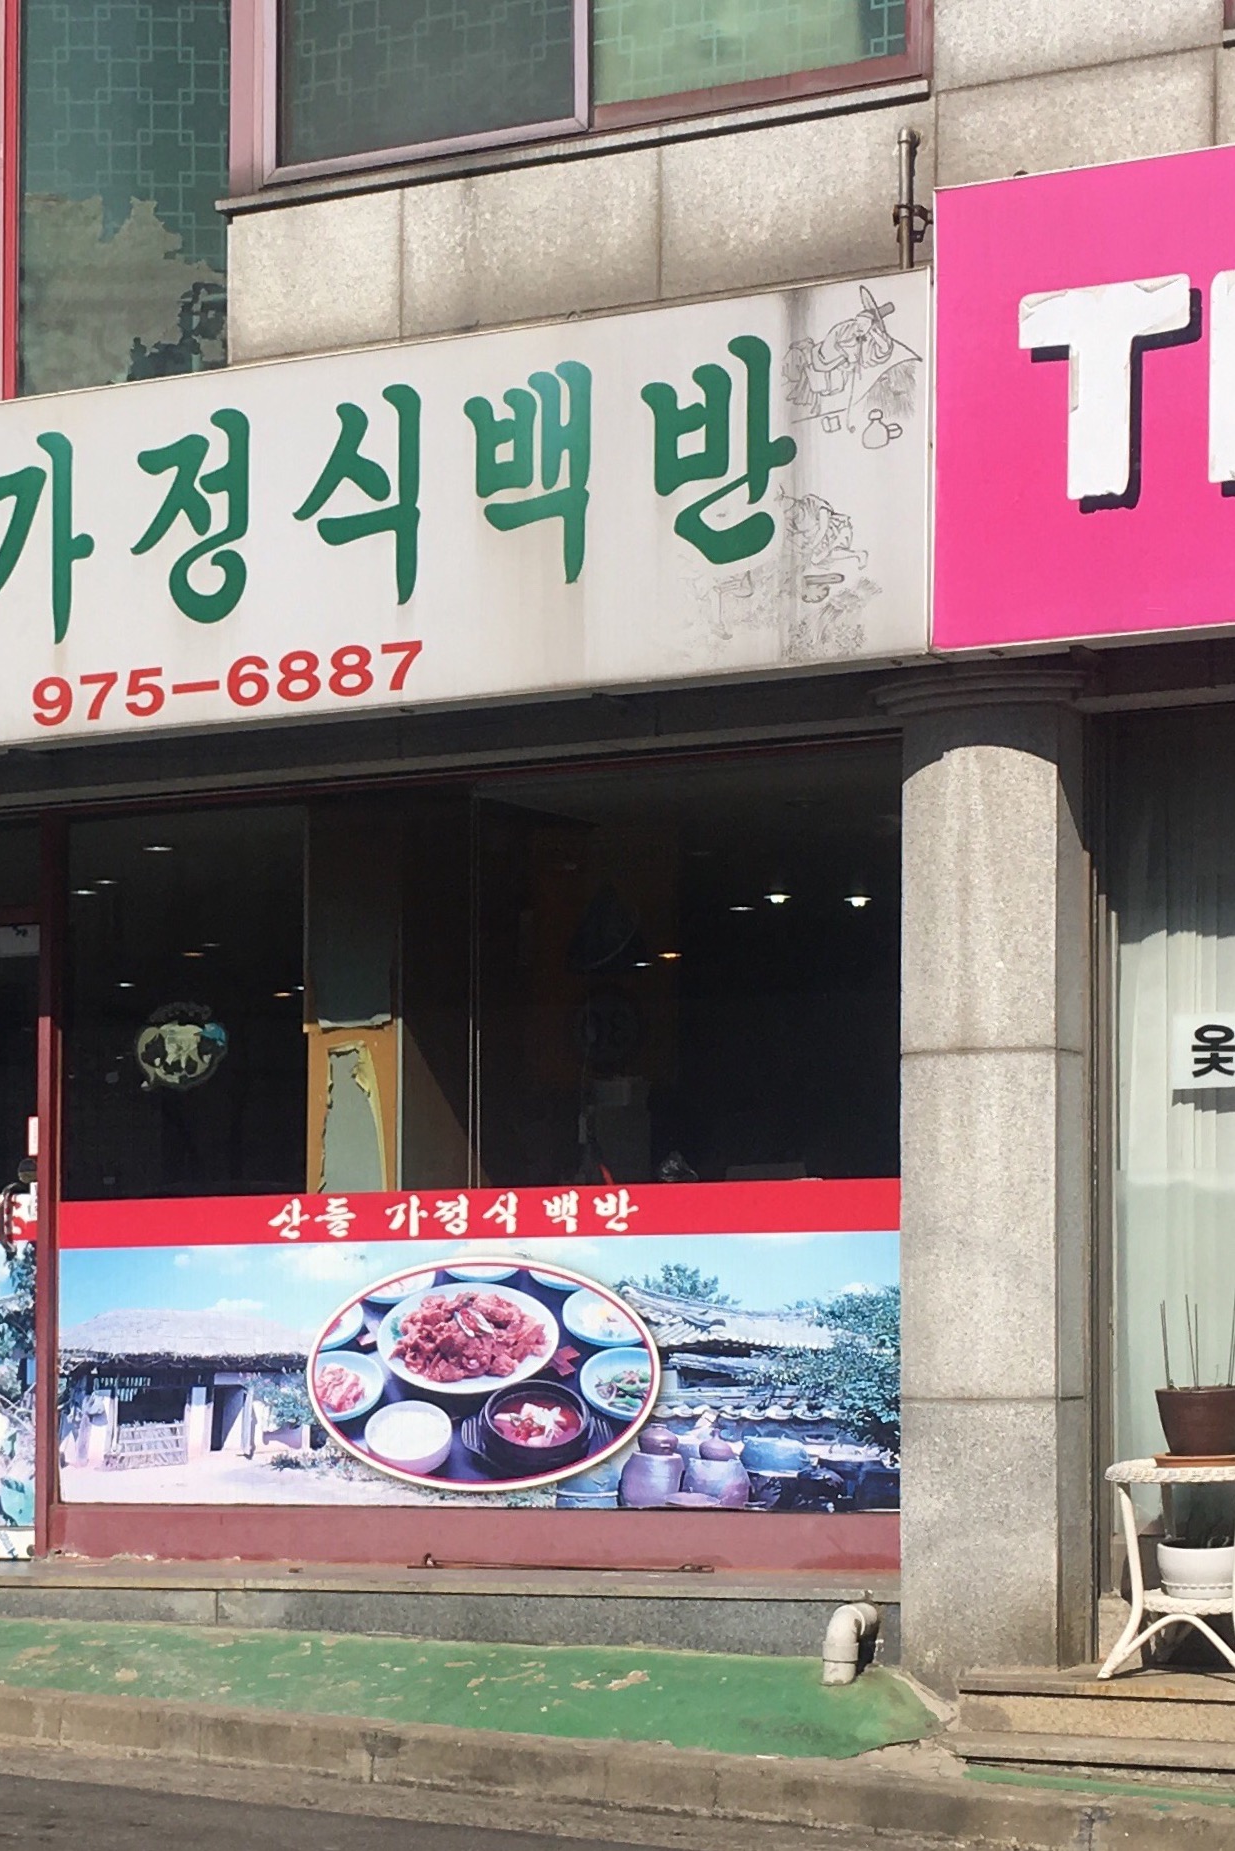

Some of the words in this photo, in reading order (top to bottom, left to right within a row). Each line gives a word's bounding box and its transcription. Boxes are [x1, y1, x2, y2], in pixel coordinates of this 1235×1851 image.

[31, 641, 423, 727] 975-6887
[268, 1198, 357, 1240] 산들
[384, 1191, 519, 1237] 가정식
[542, 1188, 639, 1234] 백반
